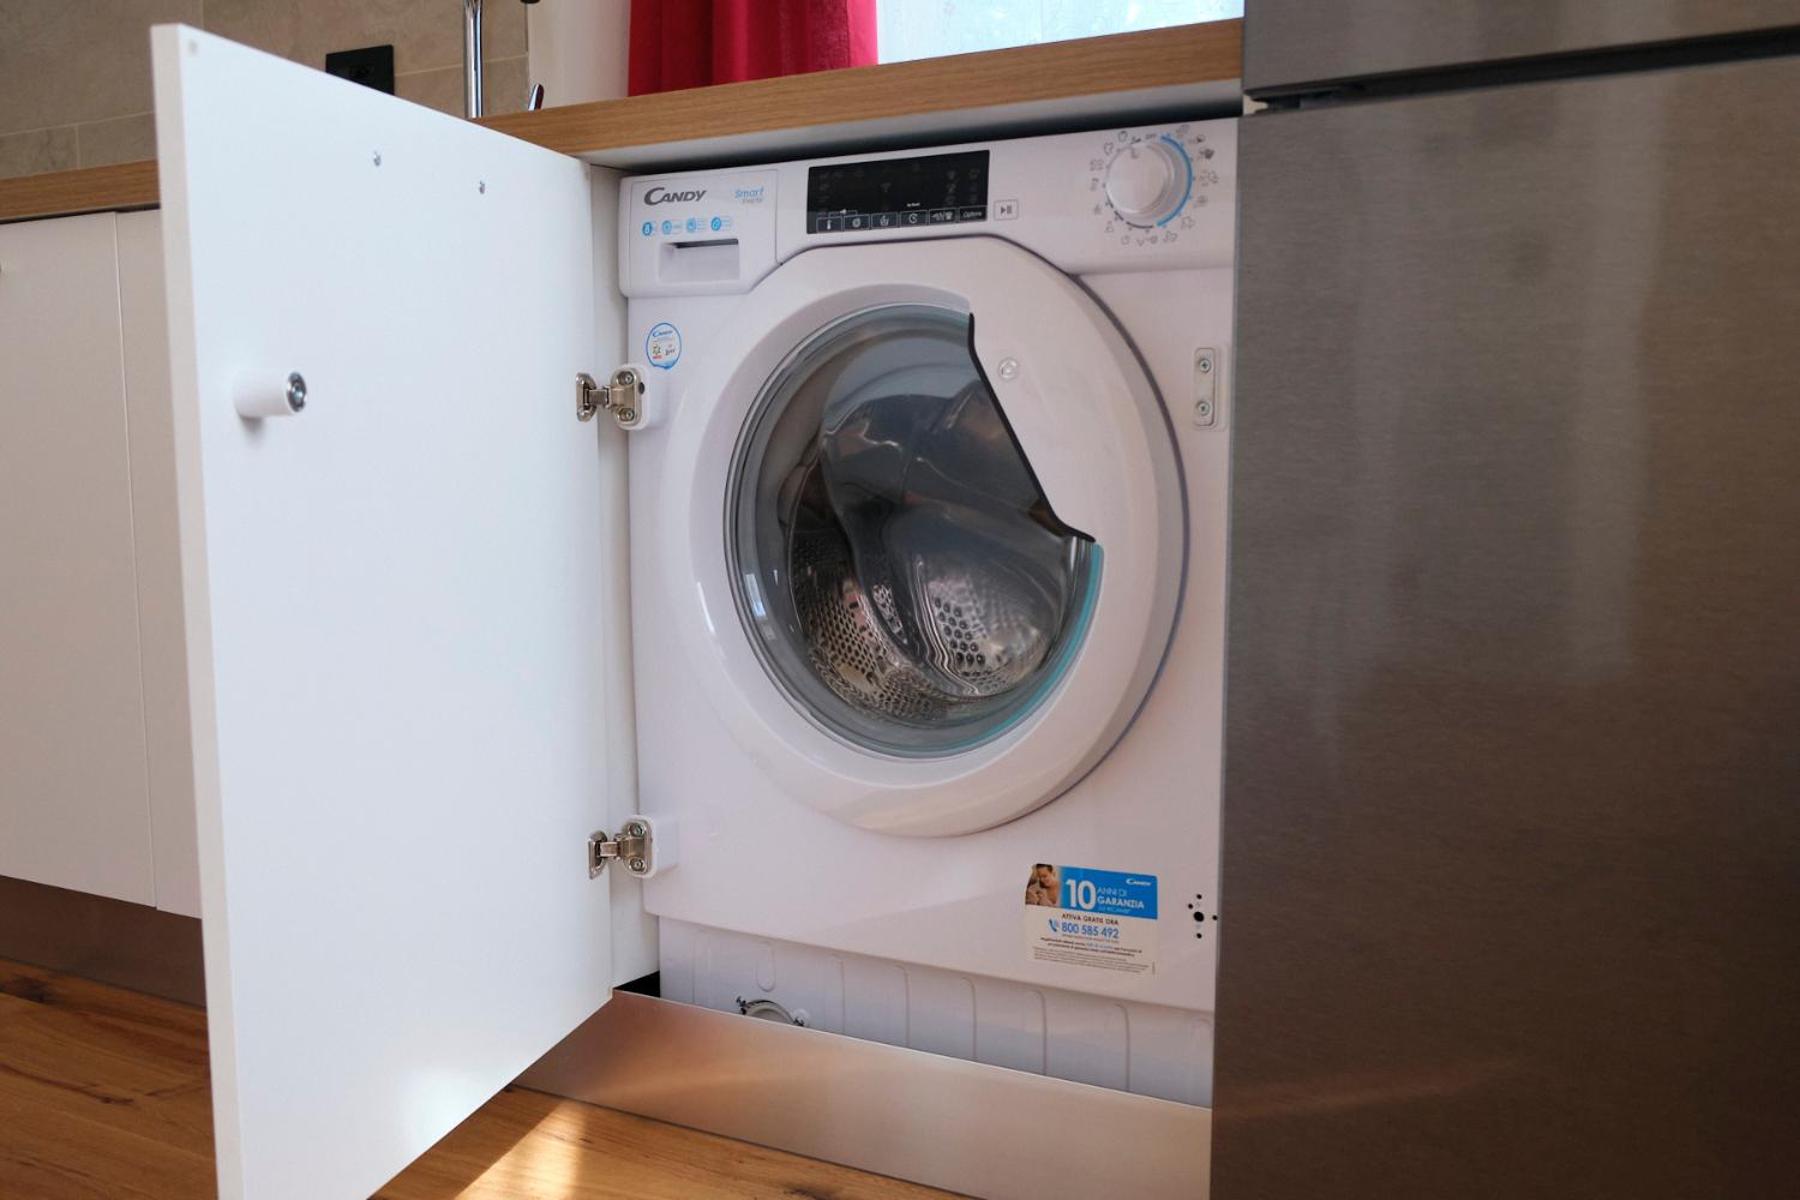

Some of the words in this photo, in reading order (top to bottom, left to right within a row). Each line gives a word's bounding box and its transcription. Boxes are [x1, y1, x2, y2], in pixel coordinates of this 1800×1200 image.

[644, 187, 707, 206] CANDY
[1065, 879, 1097, 910] 10
[1097, 886, 1117, 896] ANNI
[1119, 889, 1128, 897] DI
[1097, 896, 1145, 909] GARANZIA
[1062, 913, 1081, 921] ATTIVA
[1083, 915, 1104, 924] GRATIS
[1105, 918, 1119, 926] ORA
[1061, 922, 1080, 934] 800
[1081, 924, 1099, 937] 585
[1101, 927, 1120, 939] 492
